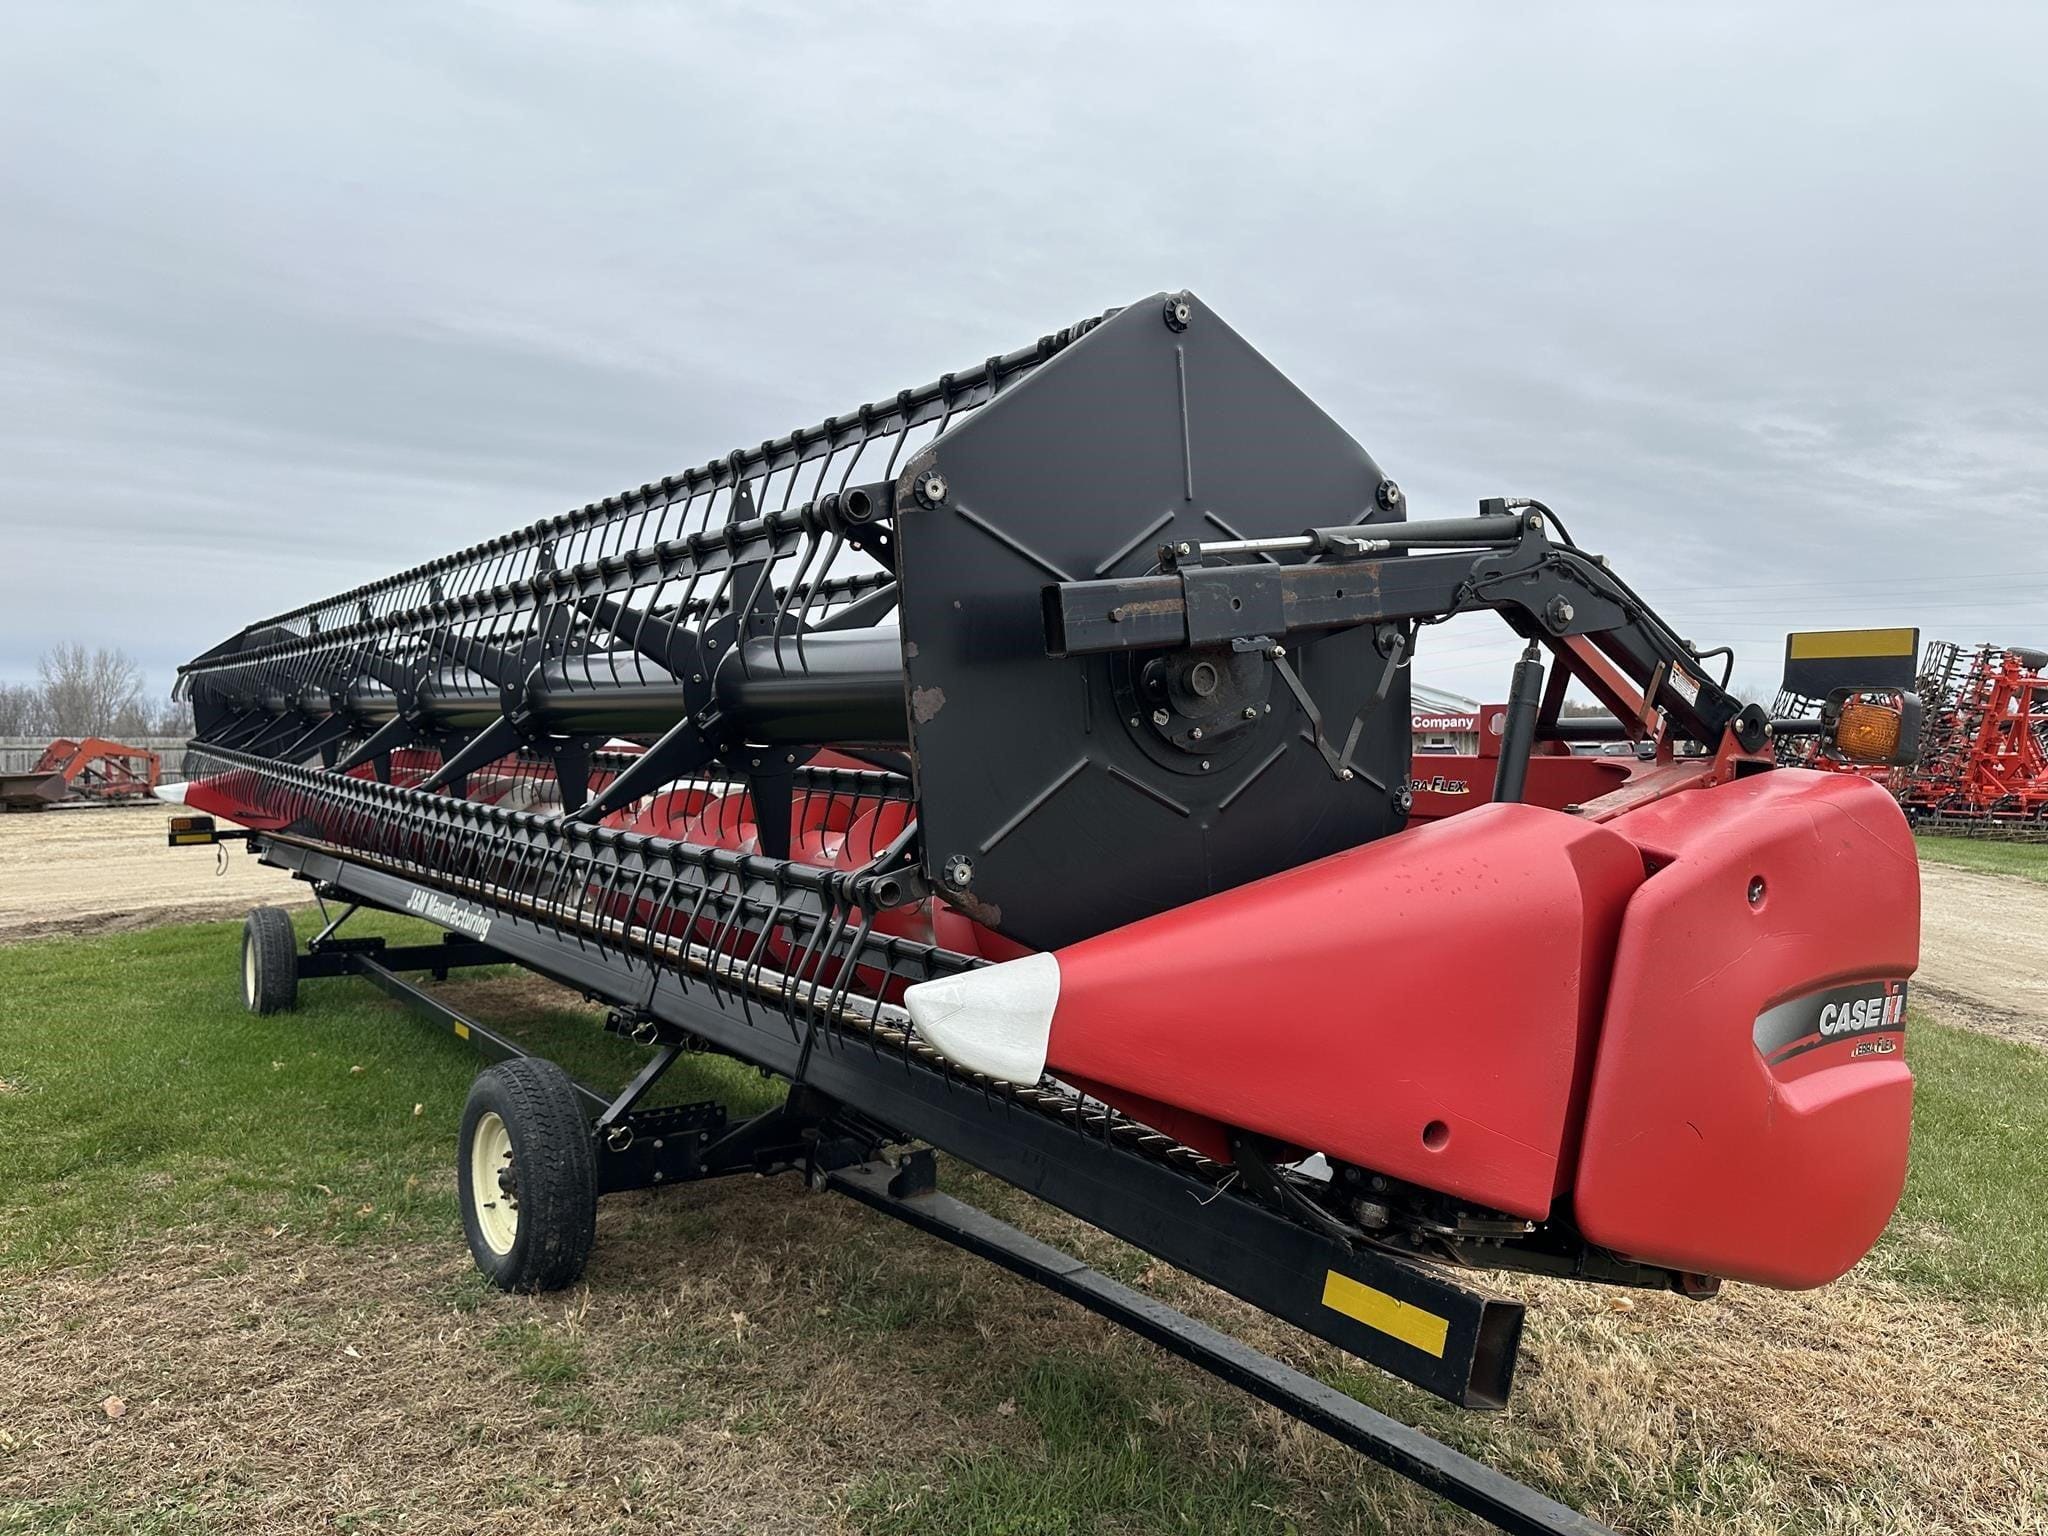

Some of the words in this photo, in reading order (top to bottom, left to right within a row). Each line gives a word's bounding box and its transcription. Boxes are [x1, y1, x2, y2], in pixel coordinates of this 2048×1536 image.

[1412, 716, 1474, 729] Company
[1430, 775, 1467, 793] FLEX
[406, 888, 430, 913] J&M
[424, 894, 492, 942] Manufacturing
